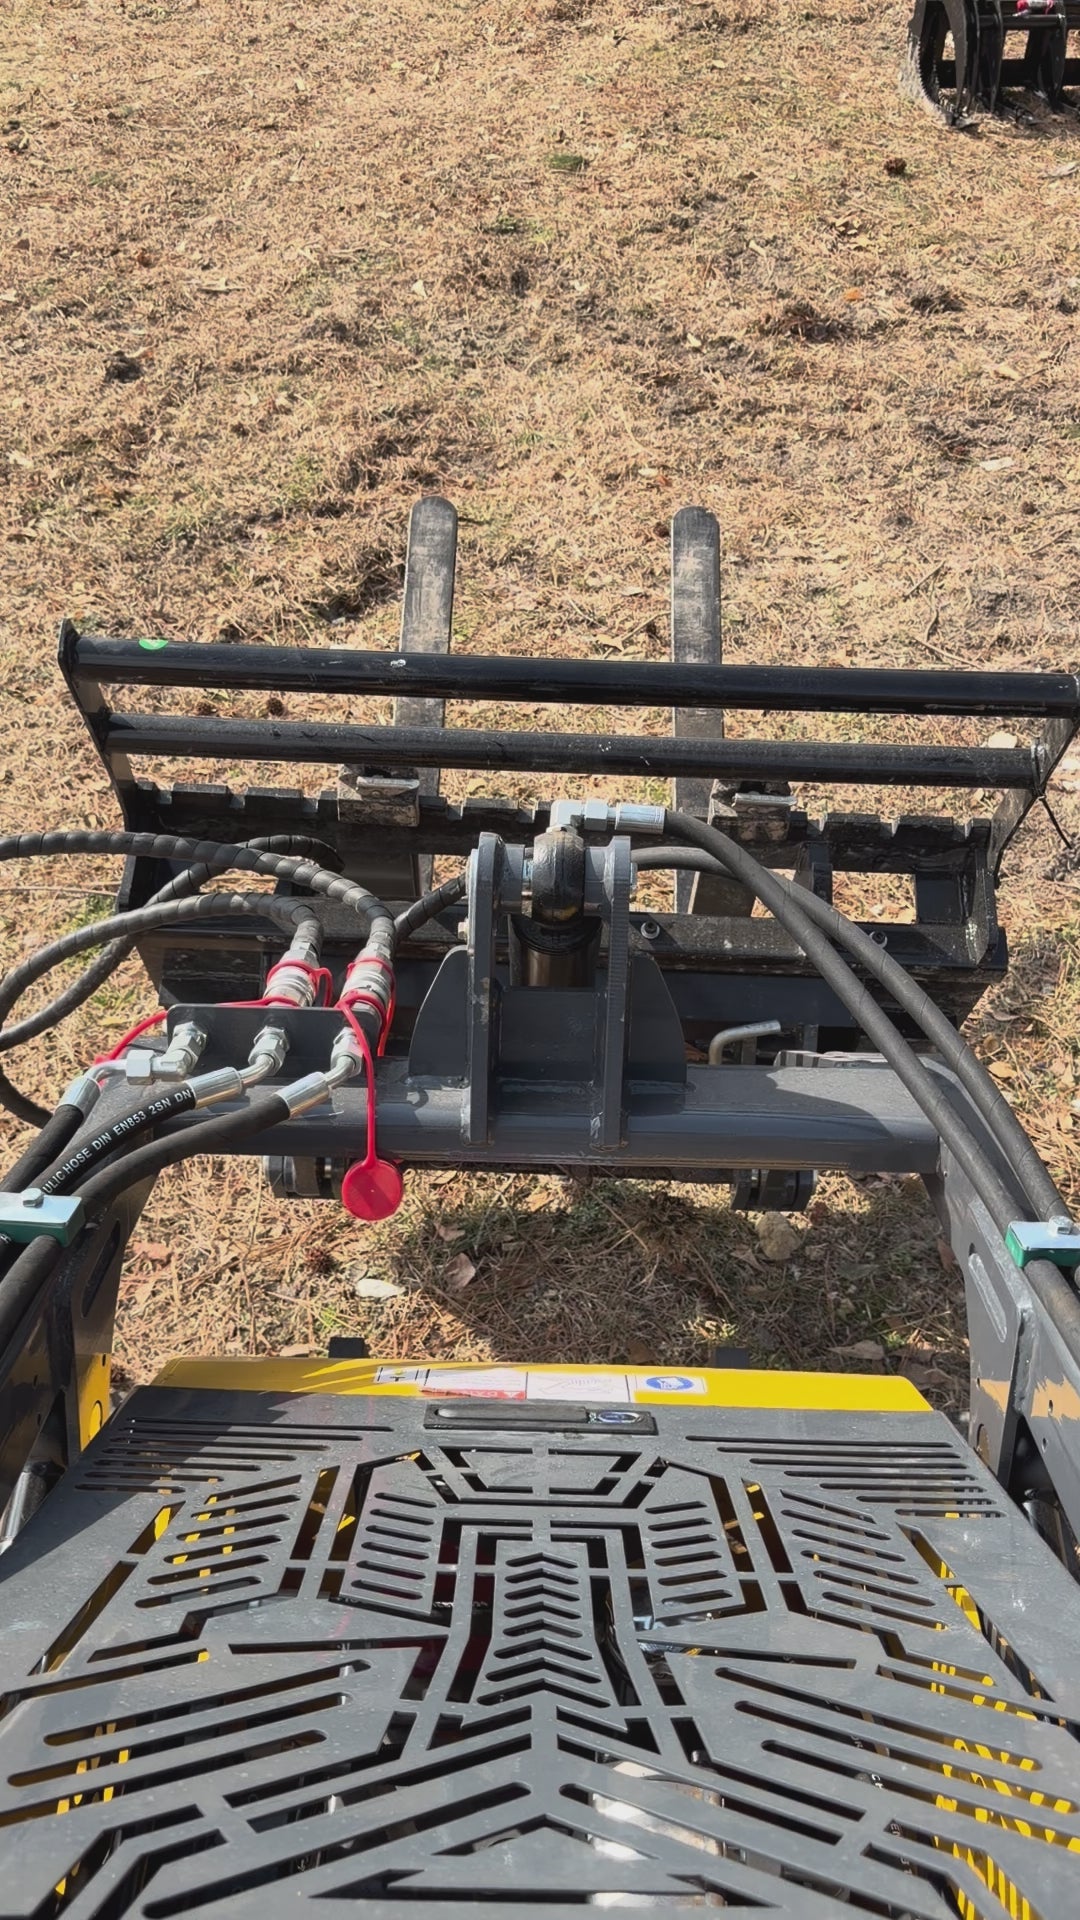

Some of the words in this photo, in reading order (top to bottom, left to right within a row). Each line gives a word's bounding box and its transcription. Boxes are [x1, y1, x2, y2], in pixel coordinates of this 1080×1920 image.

[42, 1171, 66, 1194] ULIC
[62, 1147, 93, 1175] HOSE
[92, 1132, 112, 1151] DIN
[112, 1111, 147, 1136] EN853
[149, 1097, 172, 1116] 2SN
